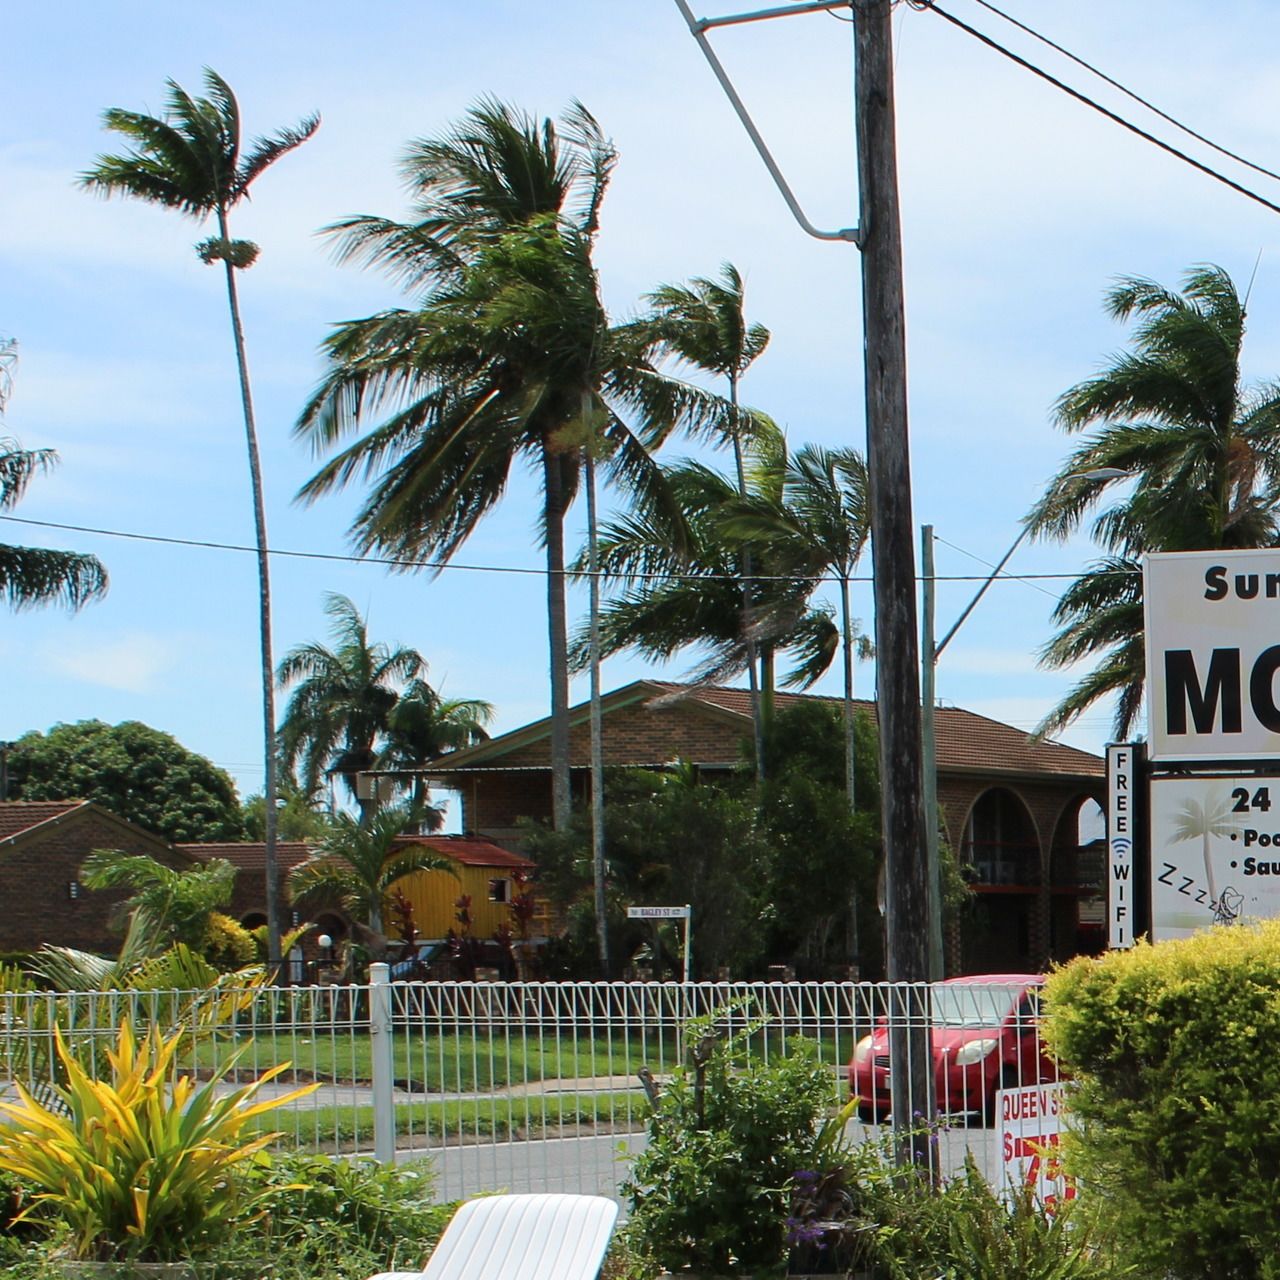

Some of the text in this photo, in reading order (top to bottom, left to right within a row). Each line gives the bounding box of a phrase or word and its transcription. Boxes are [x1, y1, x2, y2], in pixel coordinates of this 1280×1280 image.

[1116, 753, 1128, 832] FREE
[1231, 787, 1272, 813] 24
[1113, 865, 1130, 943] WIFI
[1002, 1090, 1047, 1121] QUEEN
